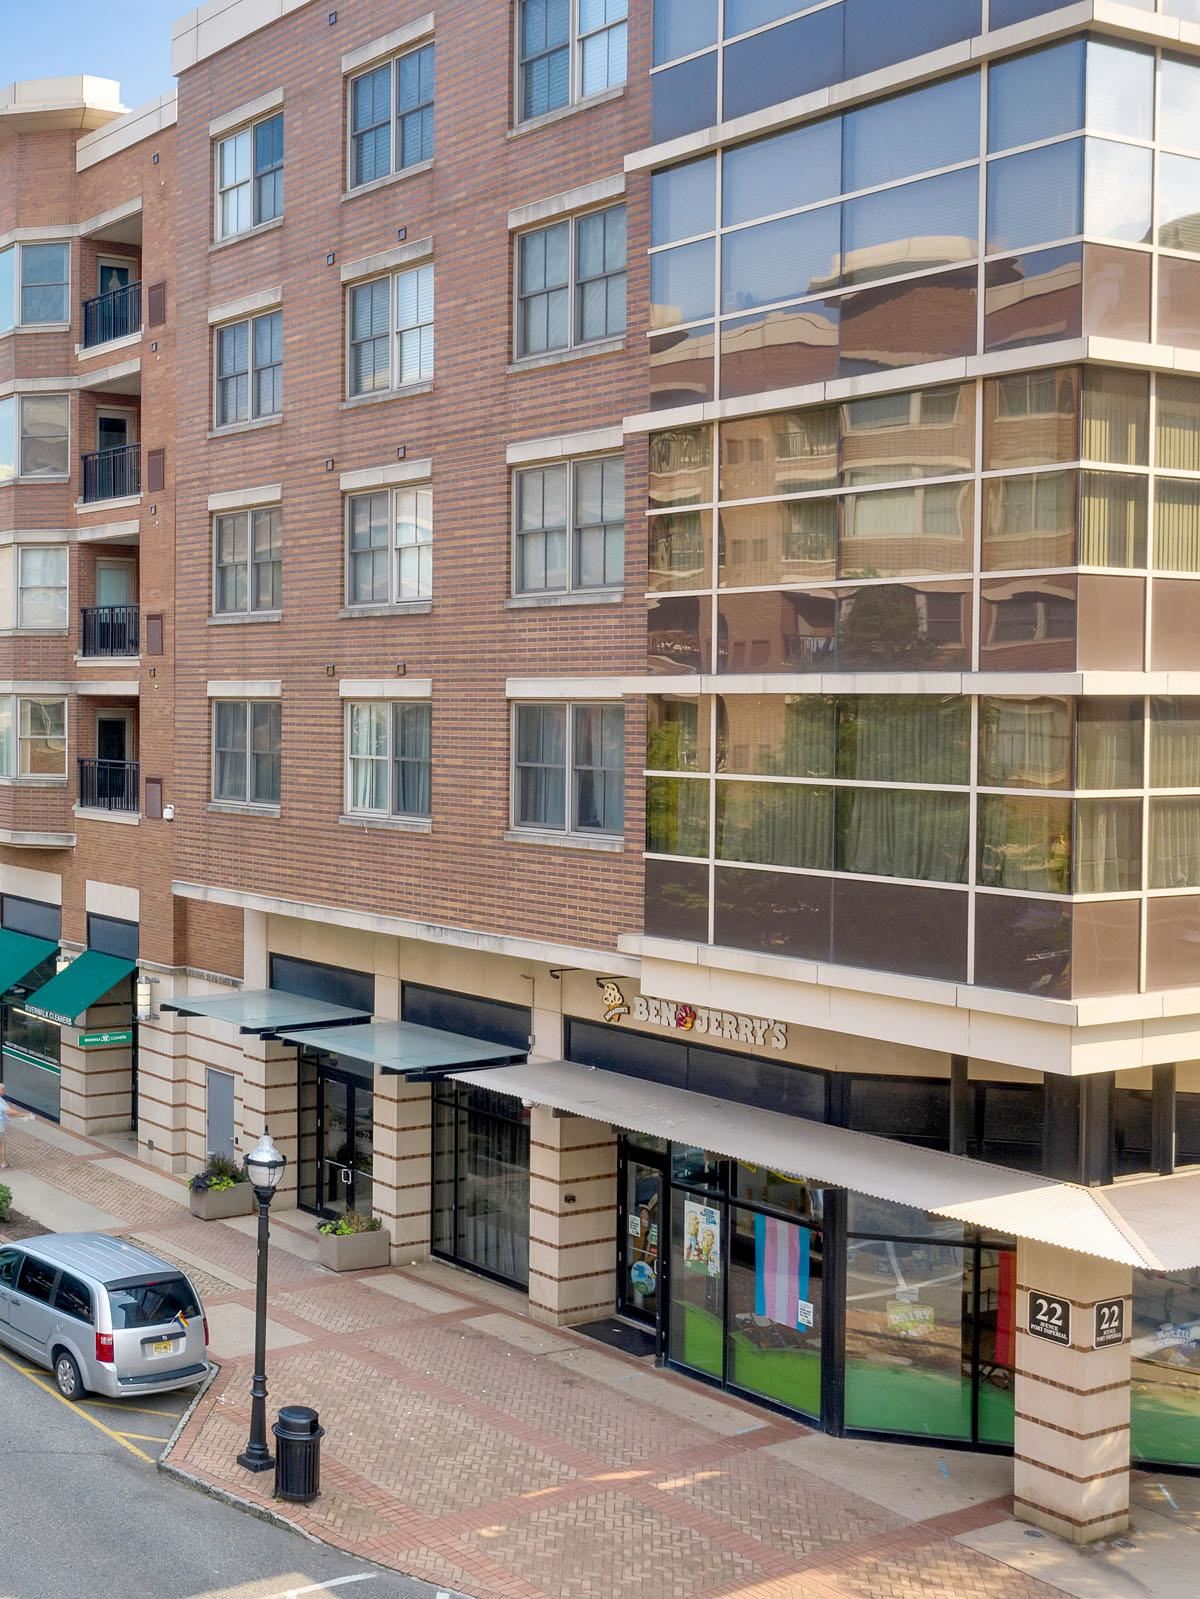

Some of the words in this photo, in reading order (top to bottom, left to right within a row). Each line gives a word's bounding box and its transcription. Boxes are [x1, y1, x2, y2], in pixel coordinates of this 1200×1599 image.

[25, 1004, 49, 1018] RIVERWALK
[49, 1012, 72, 1026] CLEANERS
[633, 996, 678, 1029] BEN
[695, 1008, 787, 1050] JERRY'S
[1035, 1298, 1063, 1326] 22
[1100, 1305, 1119, 1330] 22
[1030, 1323, 1043, 1332] PORT
[1043, 1326, 1068, 1340] IMPERIAL
[1040, 1321, 1059, 1331] AVENUE
